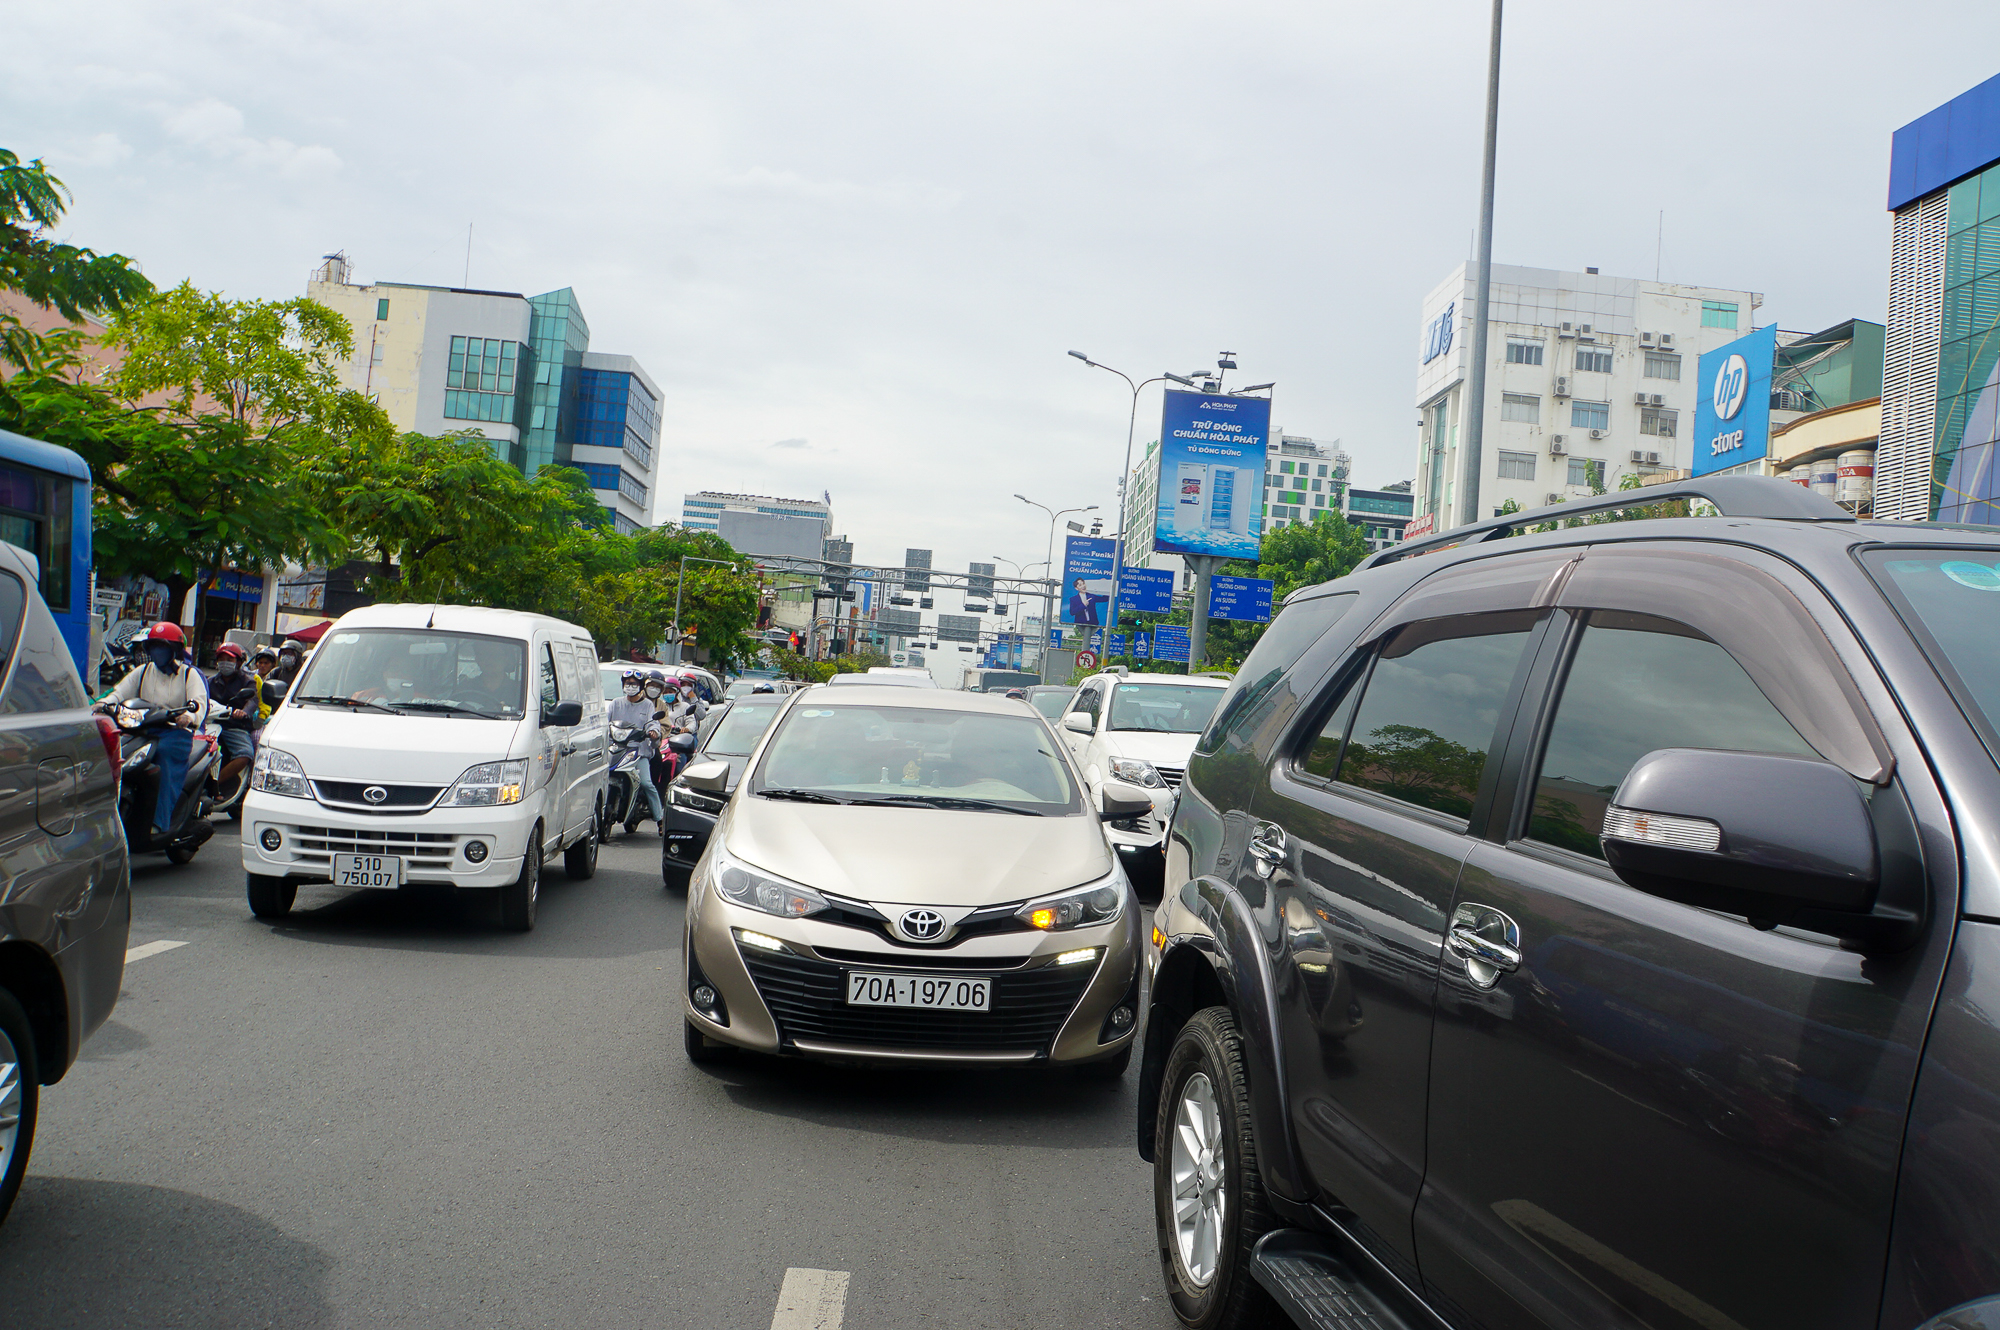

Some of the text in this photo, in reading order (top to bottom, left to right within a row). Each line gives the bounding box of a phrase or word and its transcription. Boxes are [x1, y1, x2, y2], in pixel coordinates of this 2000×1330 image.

[1192, 420, 1242, 433] TRỮ ĐÔNG
[1209, 432, 1231, 443] HÒA
[1232, 435, 1260, 445] PHÁT
[1711, 429, 1744, 456] store
[1198, 447, 1220, 455] ĐÔNG
[1091, 551, 1114, 559] Funiki
[353, 856, 382, 871] 51D
[342, 871, 393, 887] 750.07
[853, 976, 986, 1007] 70A-197.06
